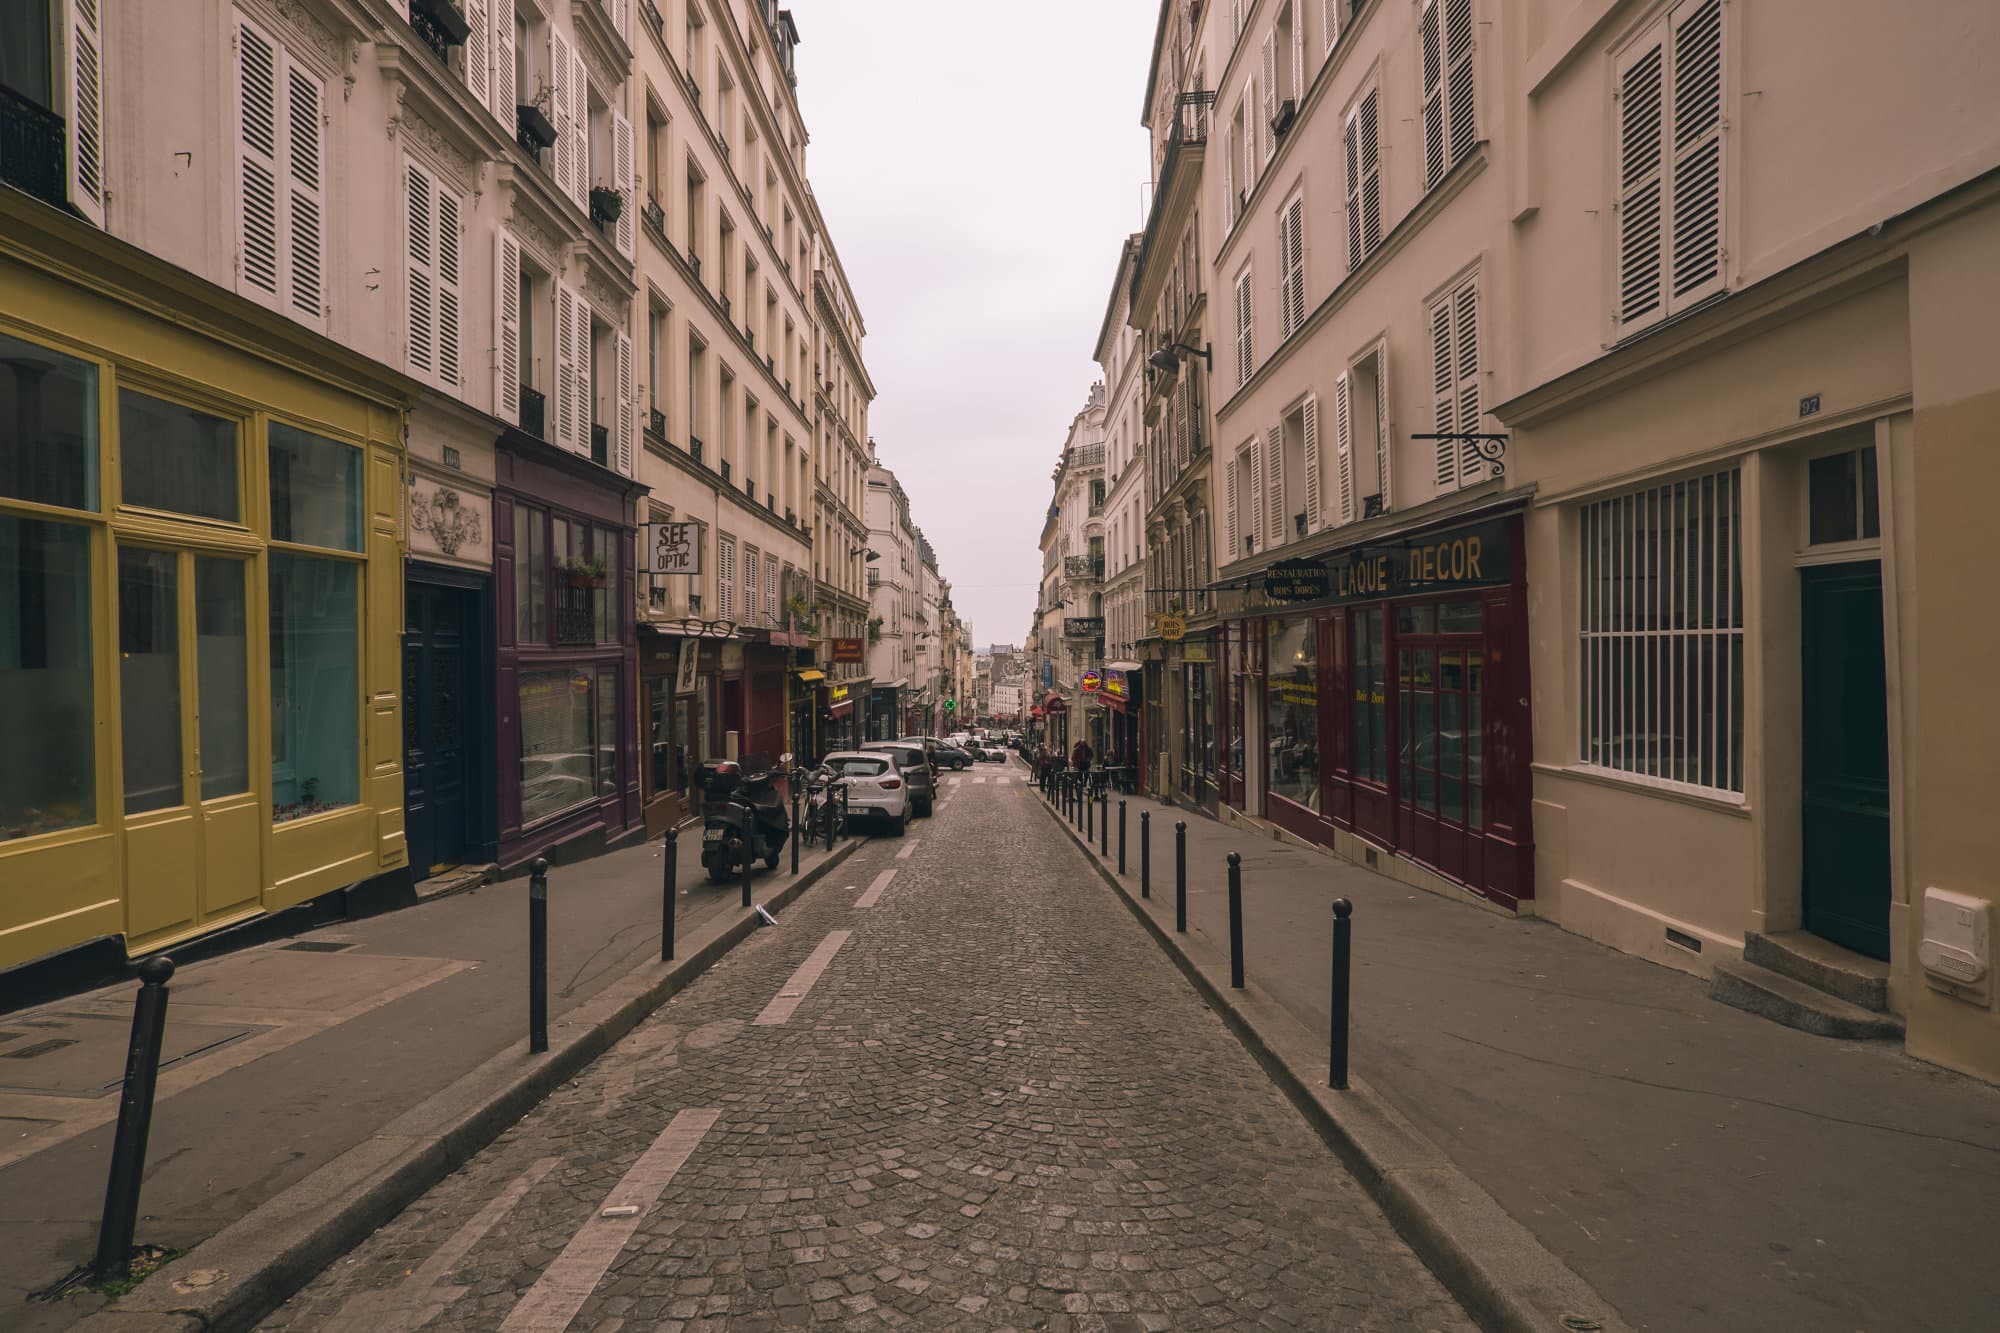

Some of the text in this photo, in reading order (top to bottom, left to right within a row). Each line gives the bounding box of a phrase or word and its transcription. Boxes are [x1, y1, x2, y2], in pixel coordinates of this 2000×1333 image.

[1802, 398, 1818, 414] 97
[659, 524, 689, 545] SEE
[657, 552, 690, 570] OPTIC
[1338, 535, 1482, 597] LAQUE DECOR
[1267, 568, 1327, 578] RESTAURATION
